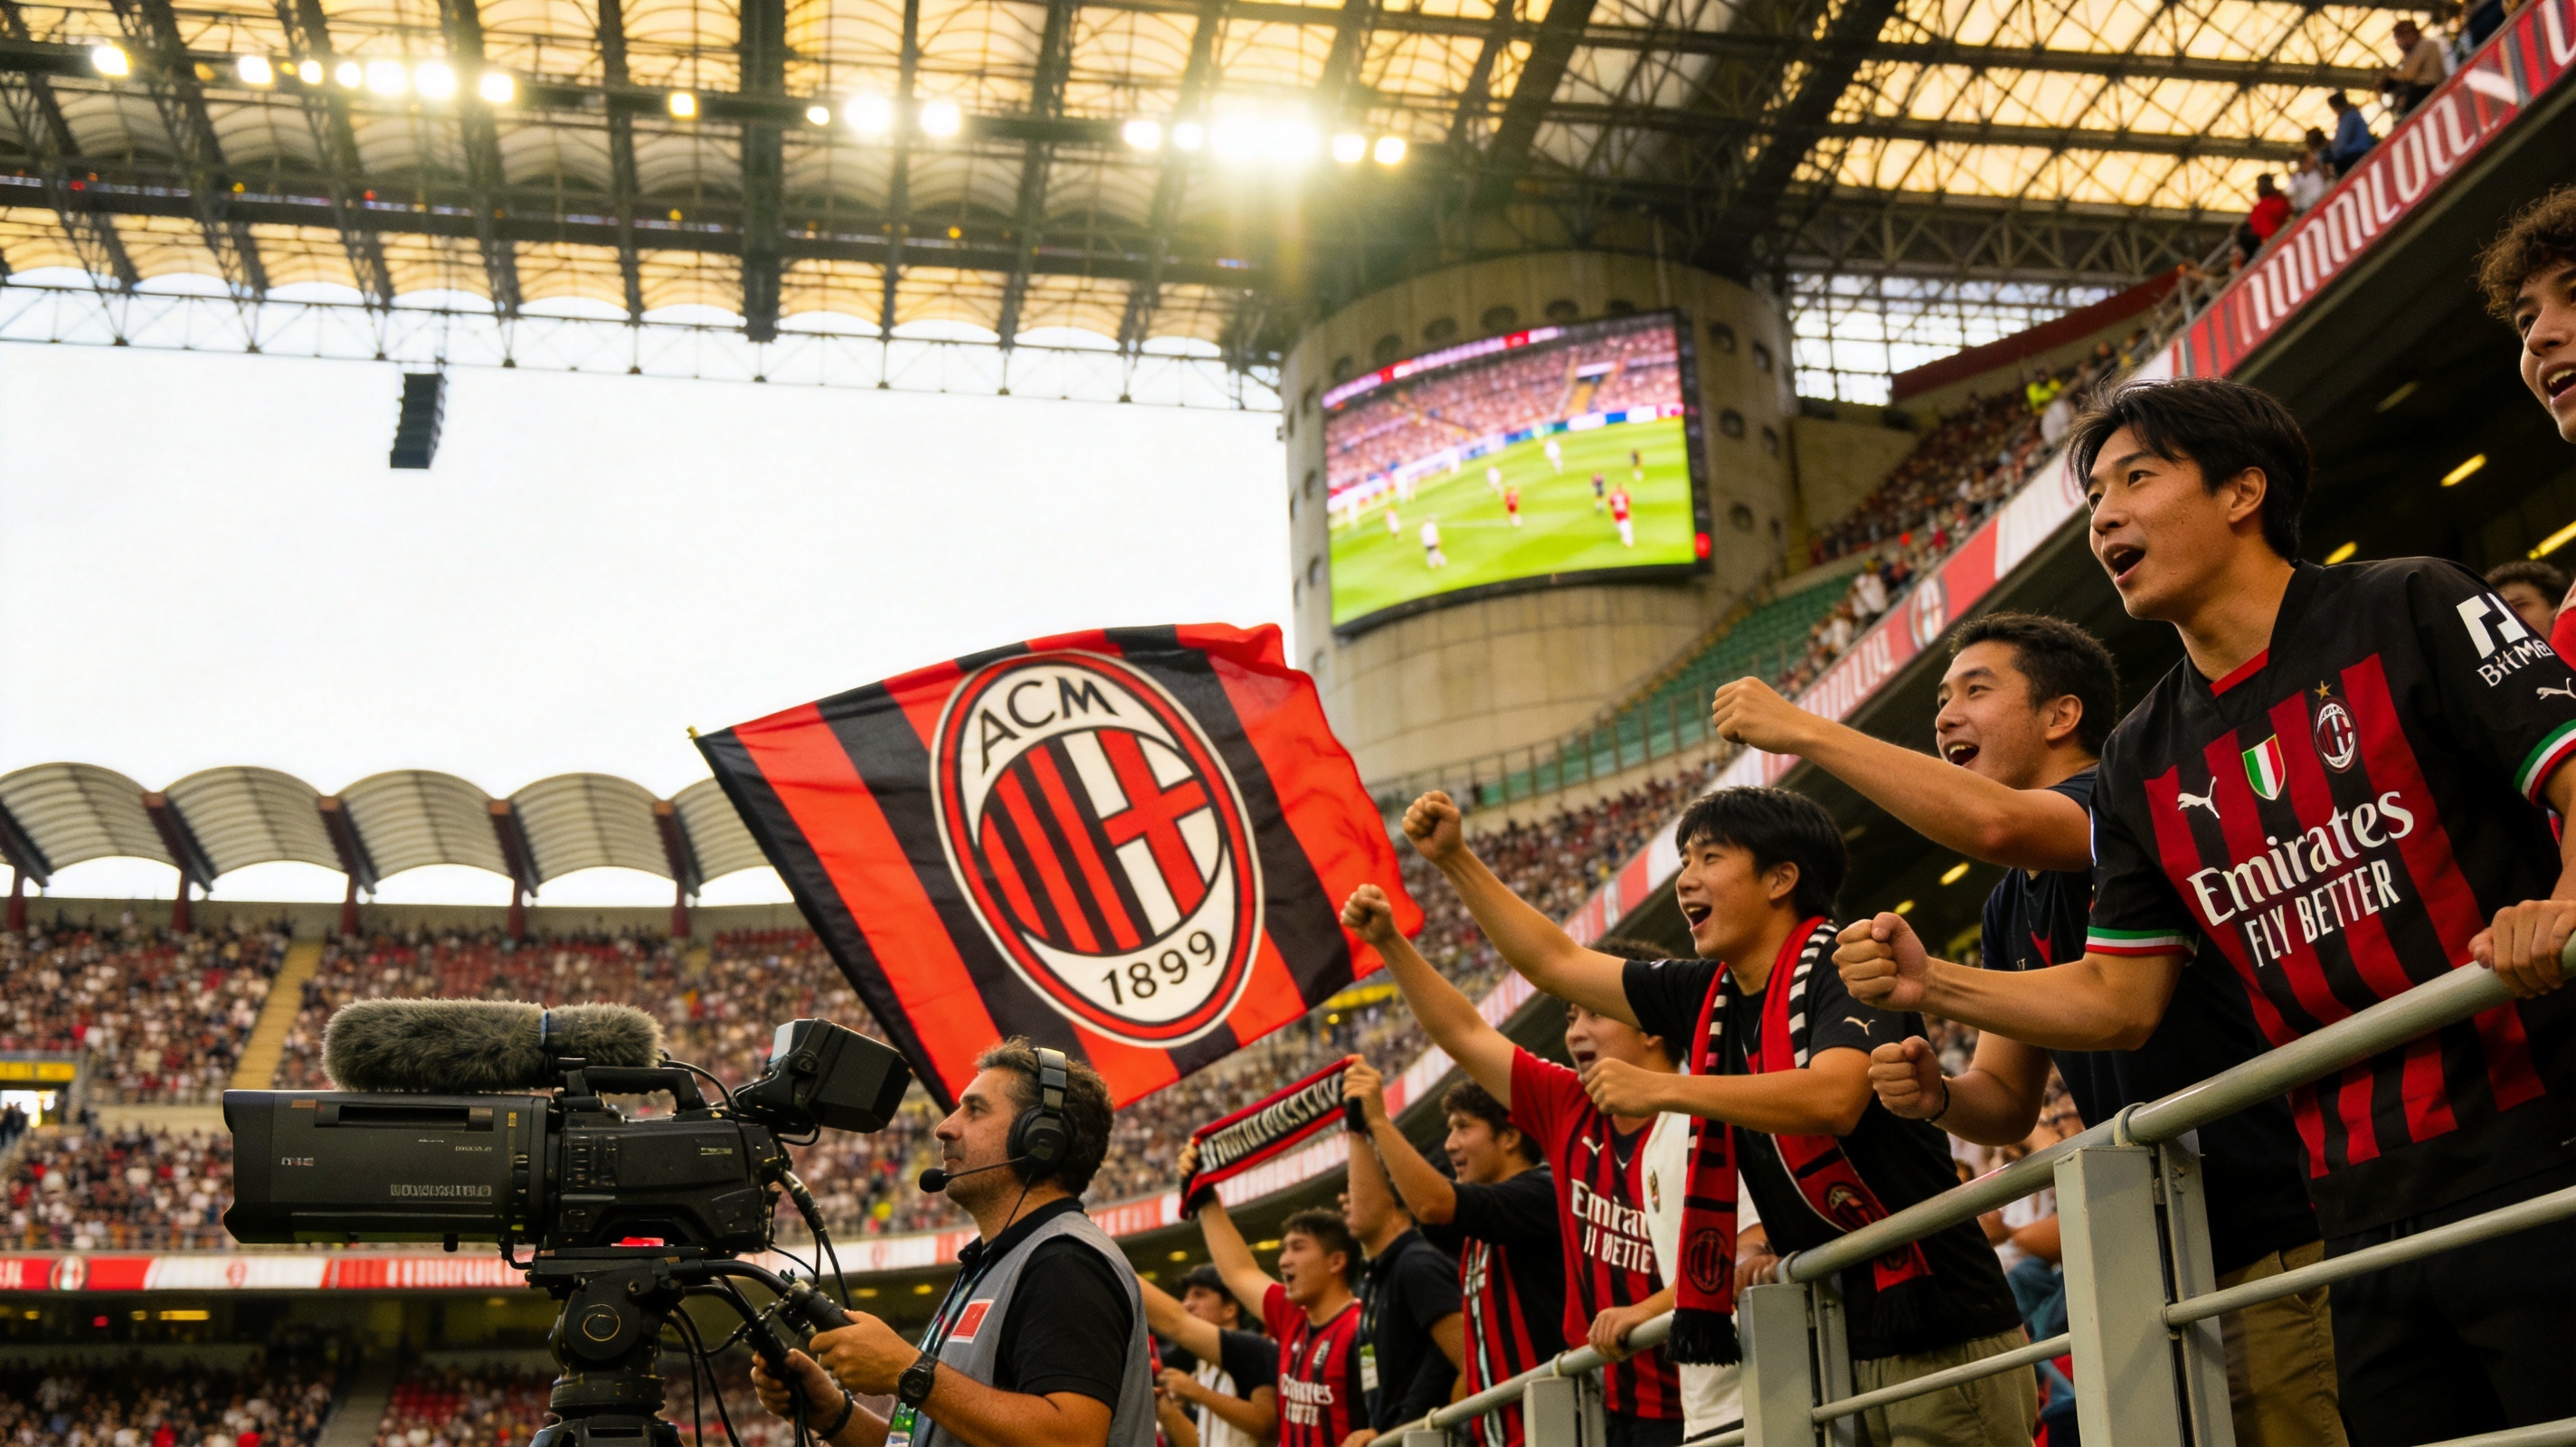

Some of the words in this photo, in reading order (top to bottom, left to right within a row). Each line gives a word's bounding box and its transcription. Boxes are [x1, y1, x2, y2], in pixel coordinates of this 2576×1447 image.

[2477, 638, 2555, 687] BitM
[980, 676, 1121, 778] ACM
[2186, 790, 2414, 926] Emirates
[2244, 904, 2292, 968] FLY
[2295, 858, 2401, 944] BETTER
[1102, 931, 1217, 1005] 1899
